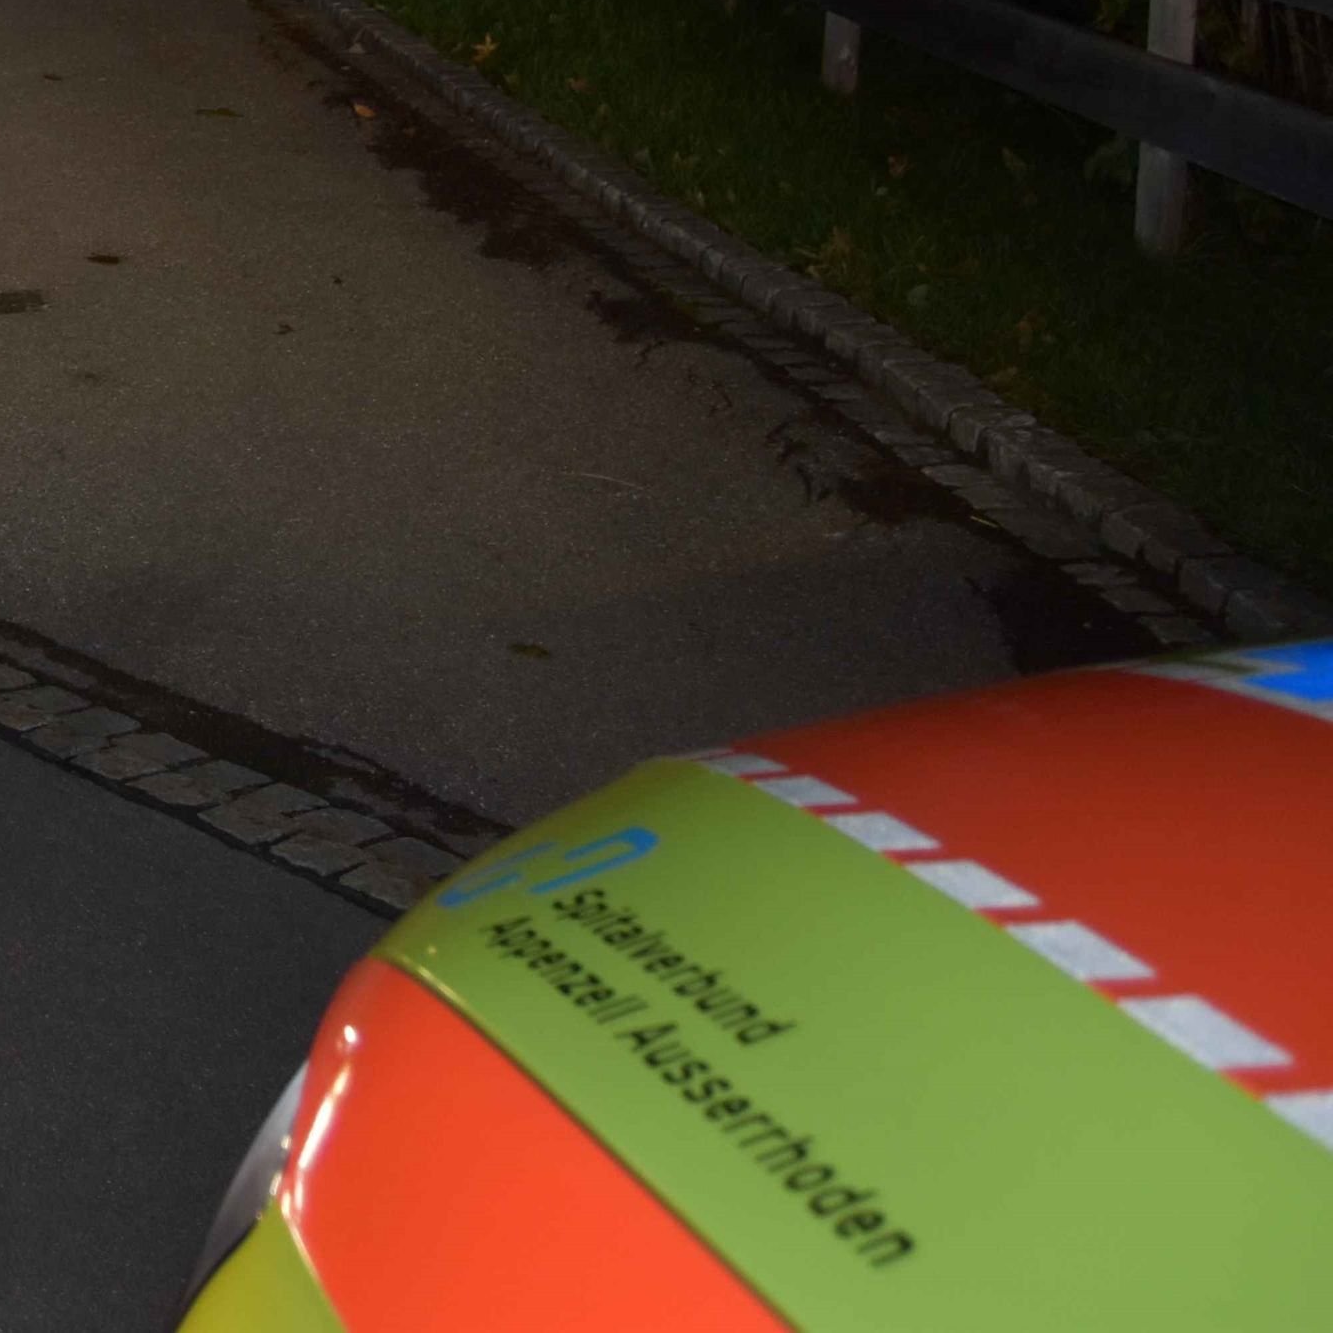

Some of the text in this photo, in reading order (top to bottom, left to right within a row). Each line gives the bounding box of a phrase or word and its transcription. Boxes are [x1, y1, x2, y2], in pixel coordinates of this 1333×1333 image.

[484, 914, 915, 1269] Appenzell Ausserrhoden
[552, 887, 794, 1046] Spitalverbund
